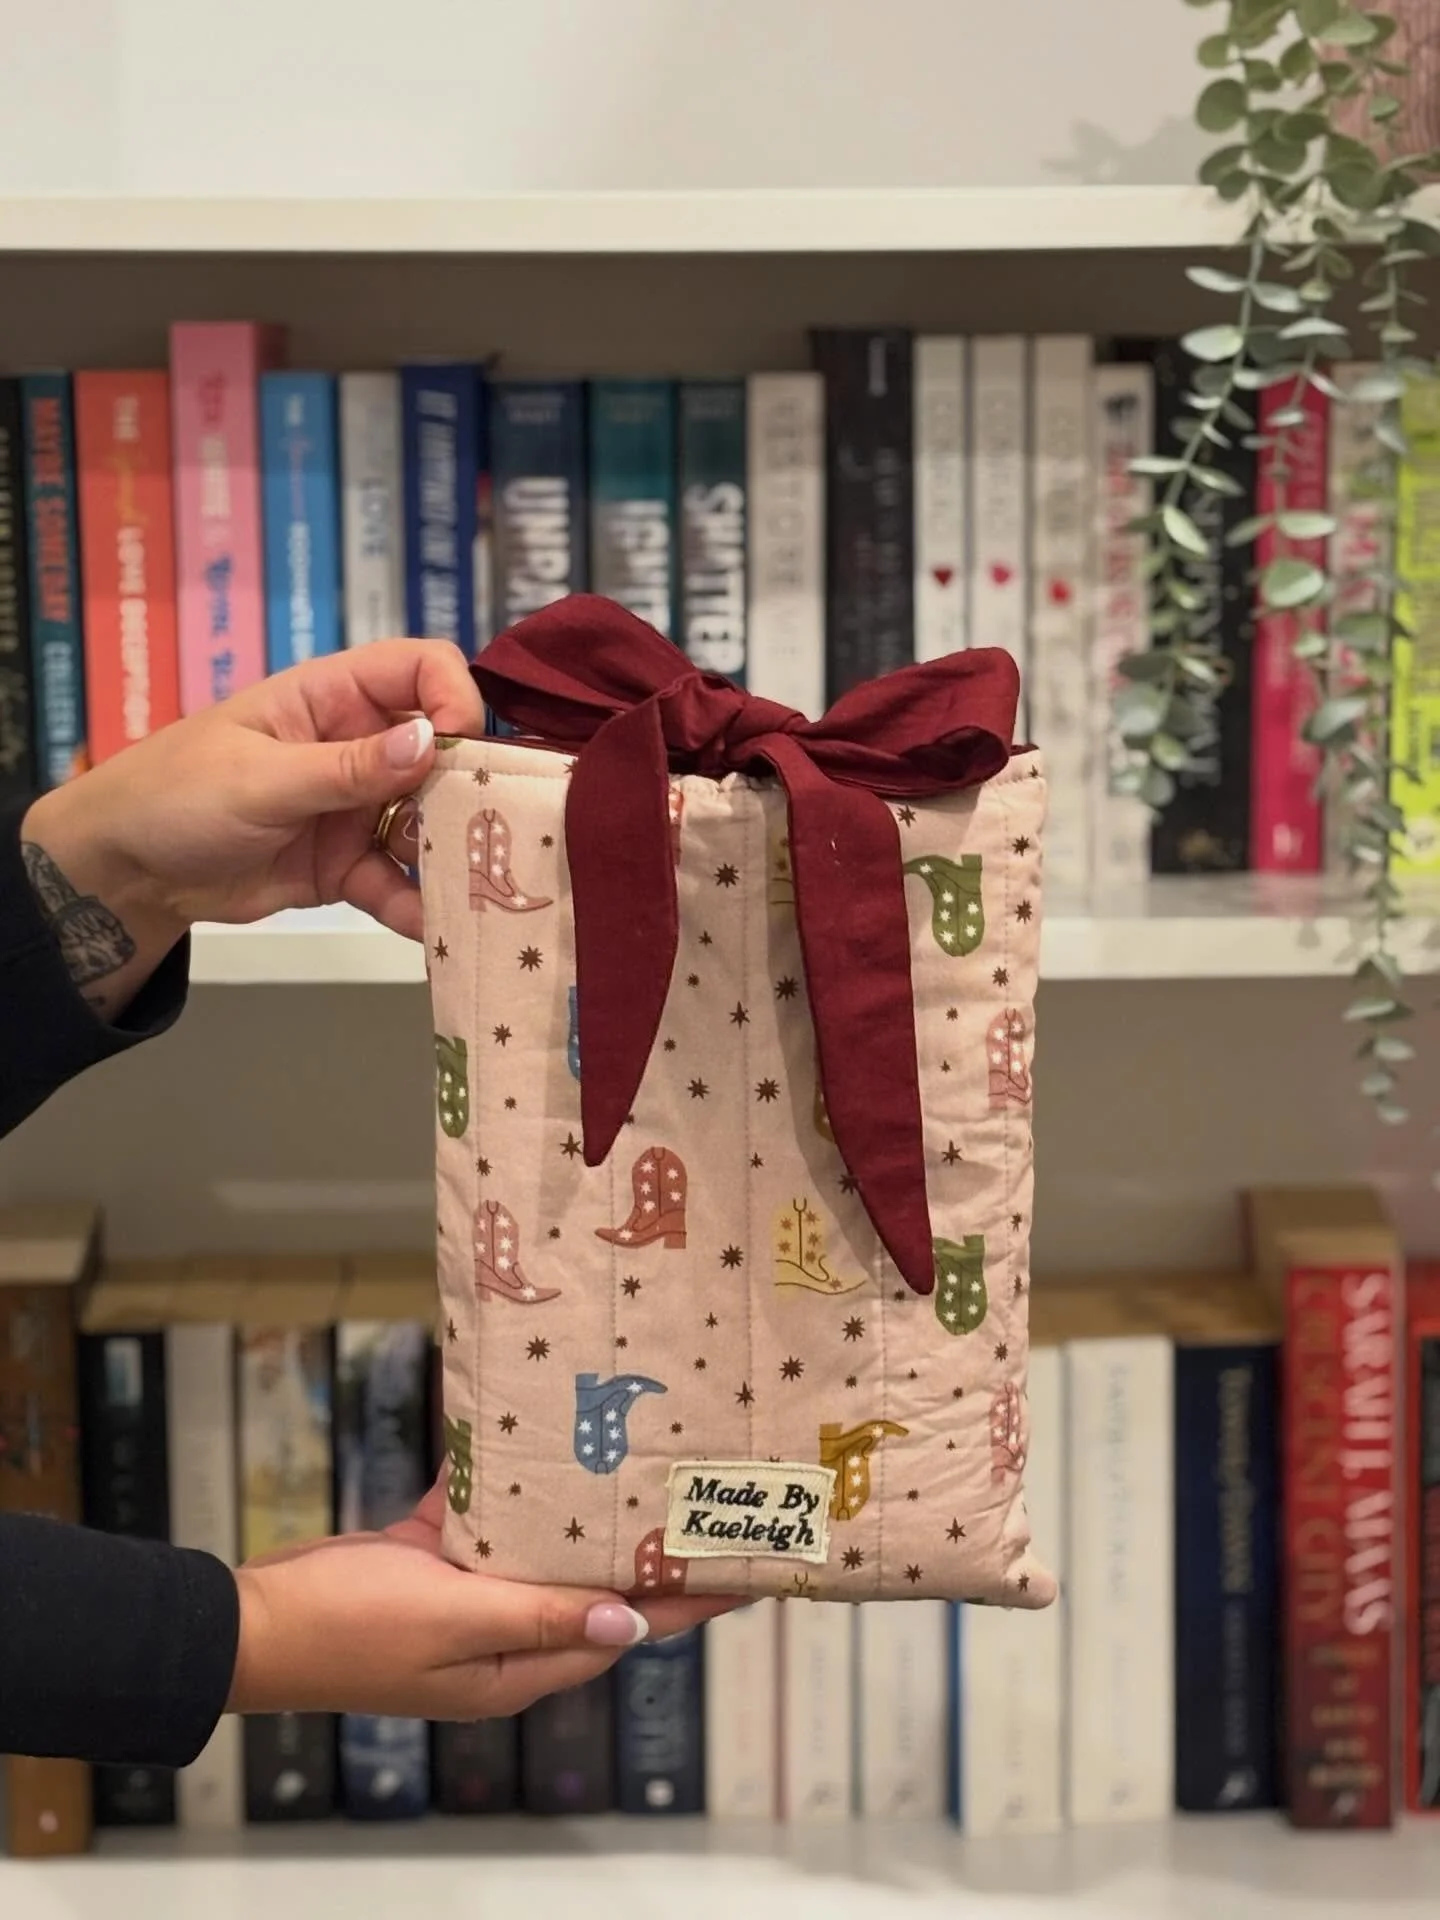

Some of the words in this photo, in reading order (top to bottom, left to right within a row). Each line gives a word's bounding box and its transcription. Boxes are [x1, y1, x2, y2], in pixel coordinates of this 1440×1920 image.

[30, 398, 64, 487] MAYBE
[685, 482, 747, 672] SHATTER
[684, 1476, 768, 1508] Made
[779, 1484, 820, 1516] By
[681, 1510, 815, 1551] Kaeleigh
